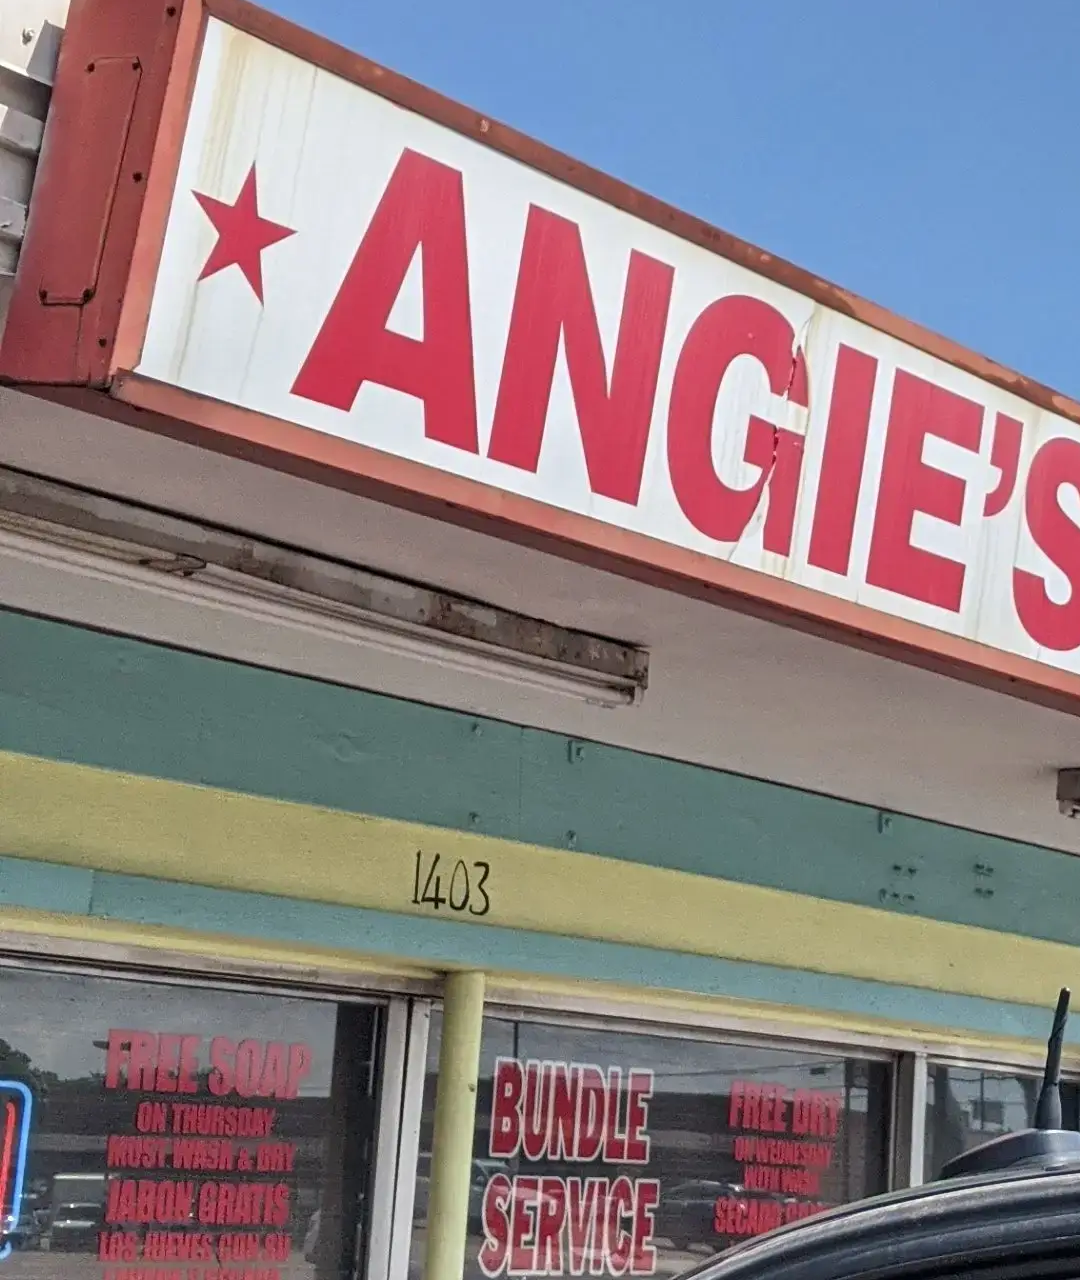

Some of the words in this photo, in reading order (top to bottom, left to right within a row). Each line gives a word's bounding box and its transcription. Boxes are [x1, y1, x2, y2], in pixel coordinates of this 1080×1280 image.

[412, 850, 490, 916] 1403
[105, 1029, 200, 1094] FREE
[207, 1035, 312, 1099] SOAP
[136, 1102, 167, 1134] ON
[171, 1103, 276, 1137] THURSDAY
[489, 1056, 653, 1164] BUNDLE
[728, 1079, 787, 1133] FREE
[791, 1086, 842, 1139] DRY
[105, 1180, 194, 1225] JABON
[199, 1183, 289, 1226] GRATIS
[478, 1173, 660, 1278] SERVICE
